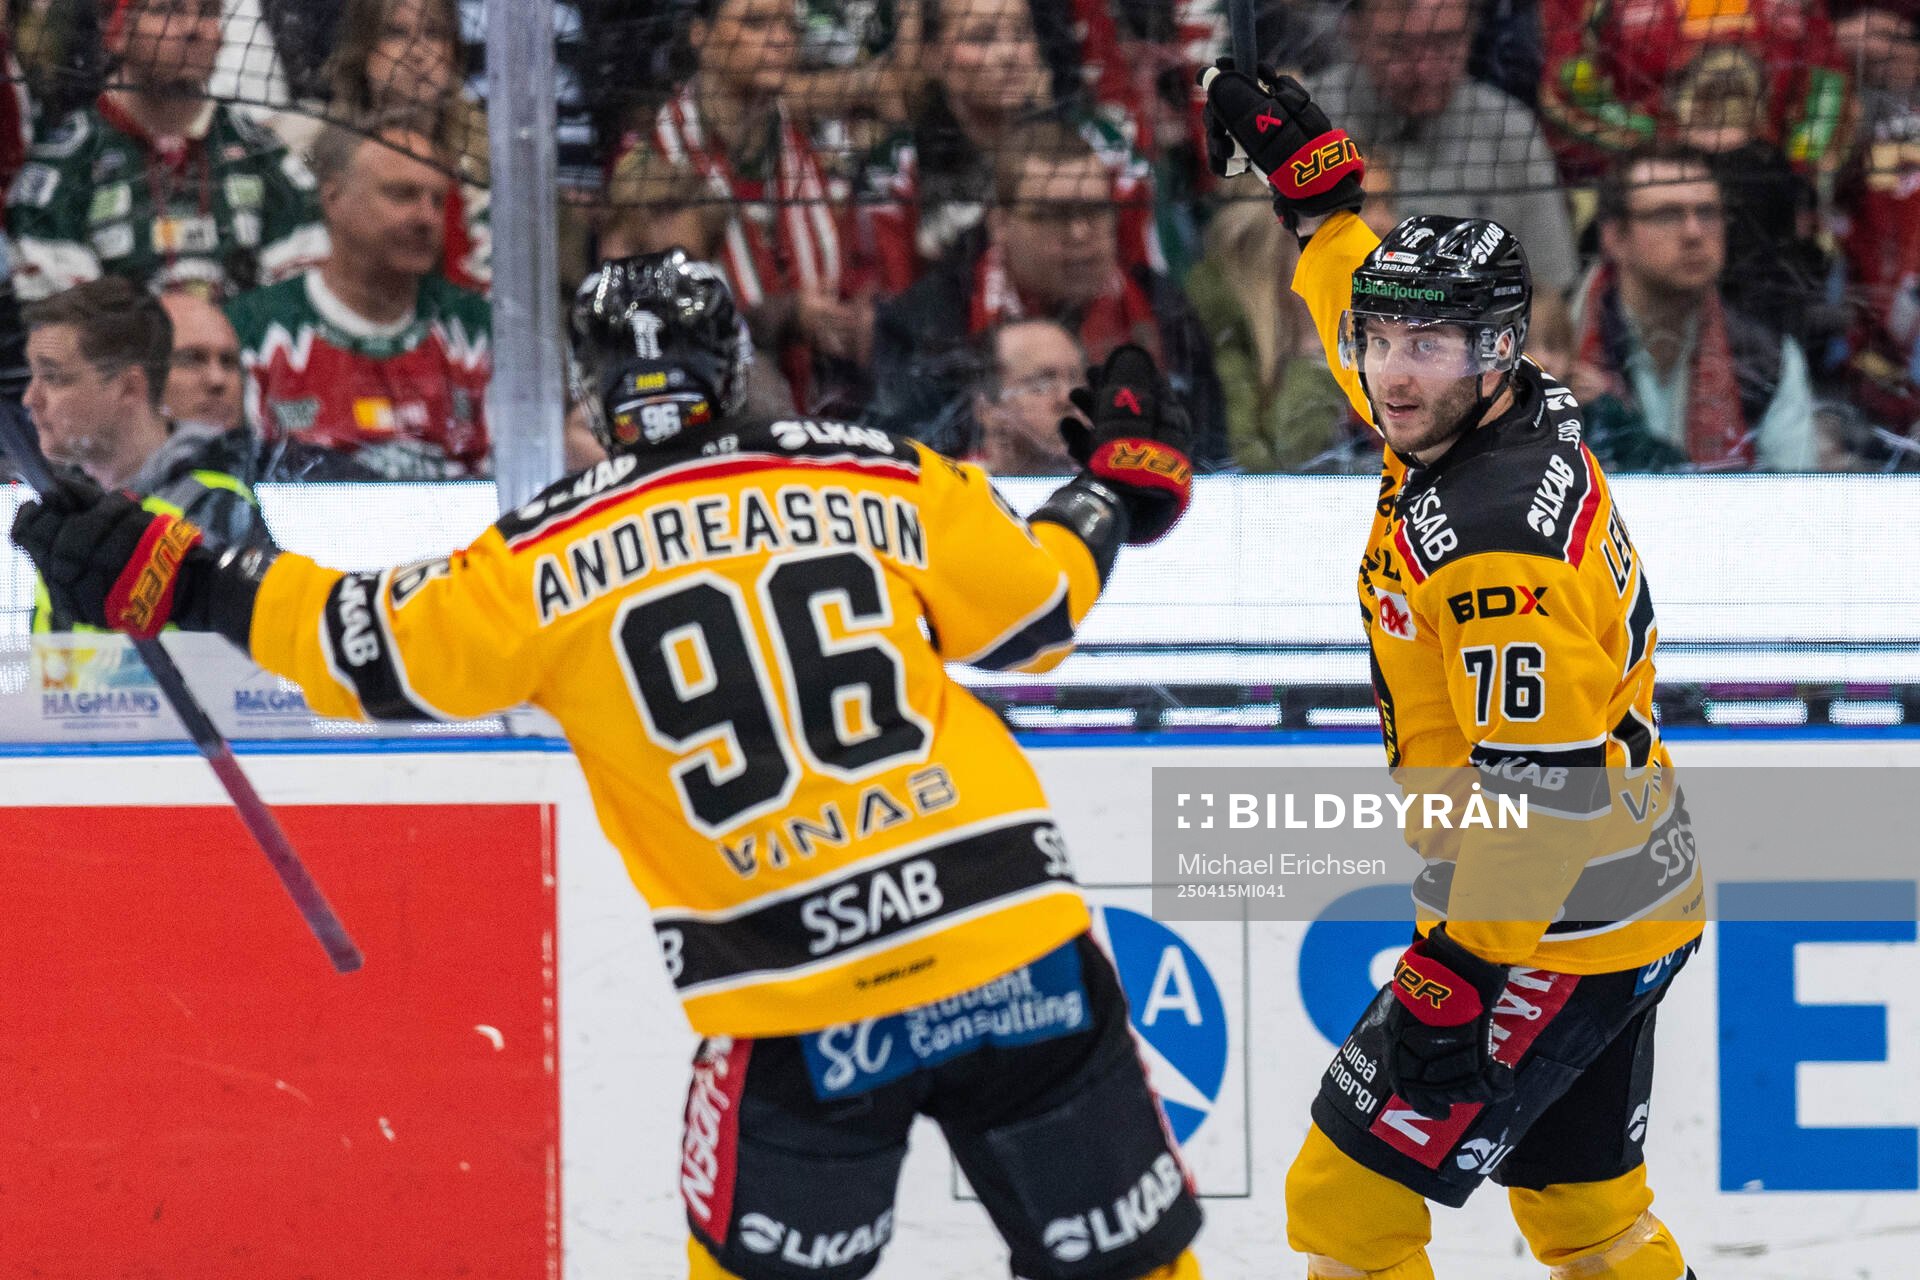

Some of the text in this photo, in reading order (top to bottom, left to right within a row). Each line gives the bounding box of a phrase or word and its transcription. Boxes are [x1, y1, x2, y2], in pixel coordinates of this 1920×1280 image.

[1484, 222, 1505, 257] LKAB
[641, 402, 682, 444] 96
[1409, 486, 1459, 562] SSAB
[1539, 453, 1575, 520] LKAB
[534, 486, 930, 628] ANDREASSON
[42, 692, 161, 714] HAGMANS
[611, 543, 935, 835] 96
[1460, 641, 1546, 726] 76
[718, 765, 958, 880] VINAB
[801, 859, 945, 955] SSAB
[909, 990, 1083, 1058] Consulting
[1342, 1034, 1377, 1084] Luleå
[1087, 1154, 1184, 1253] LKAB
